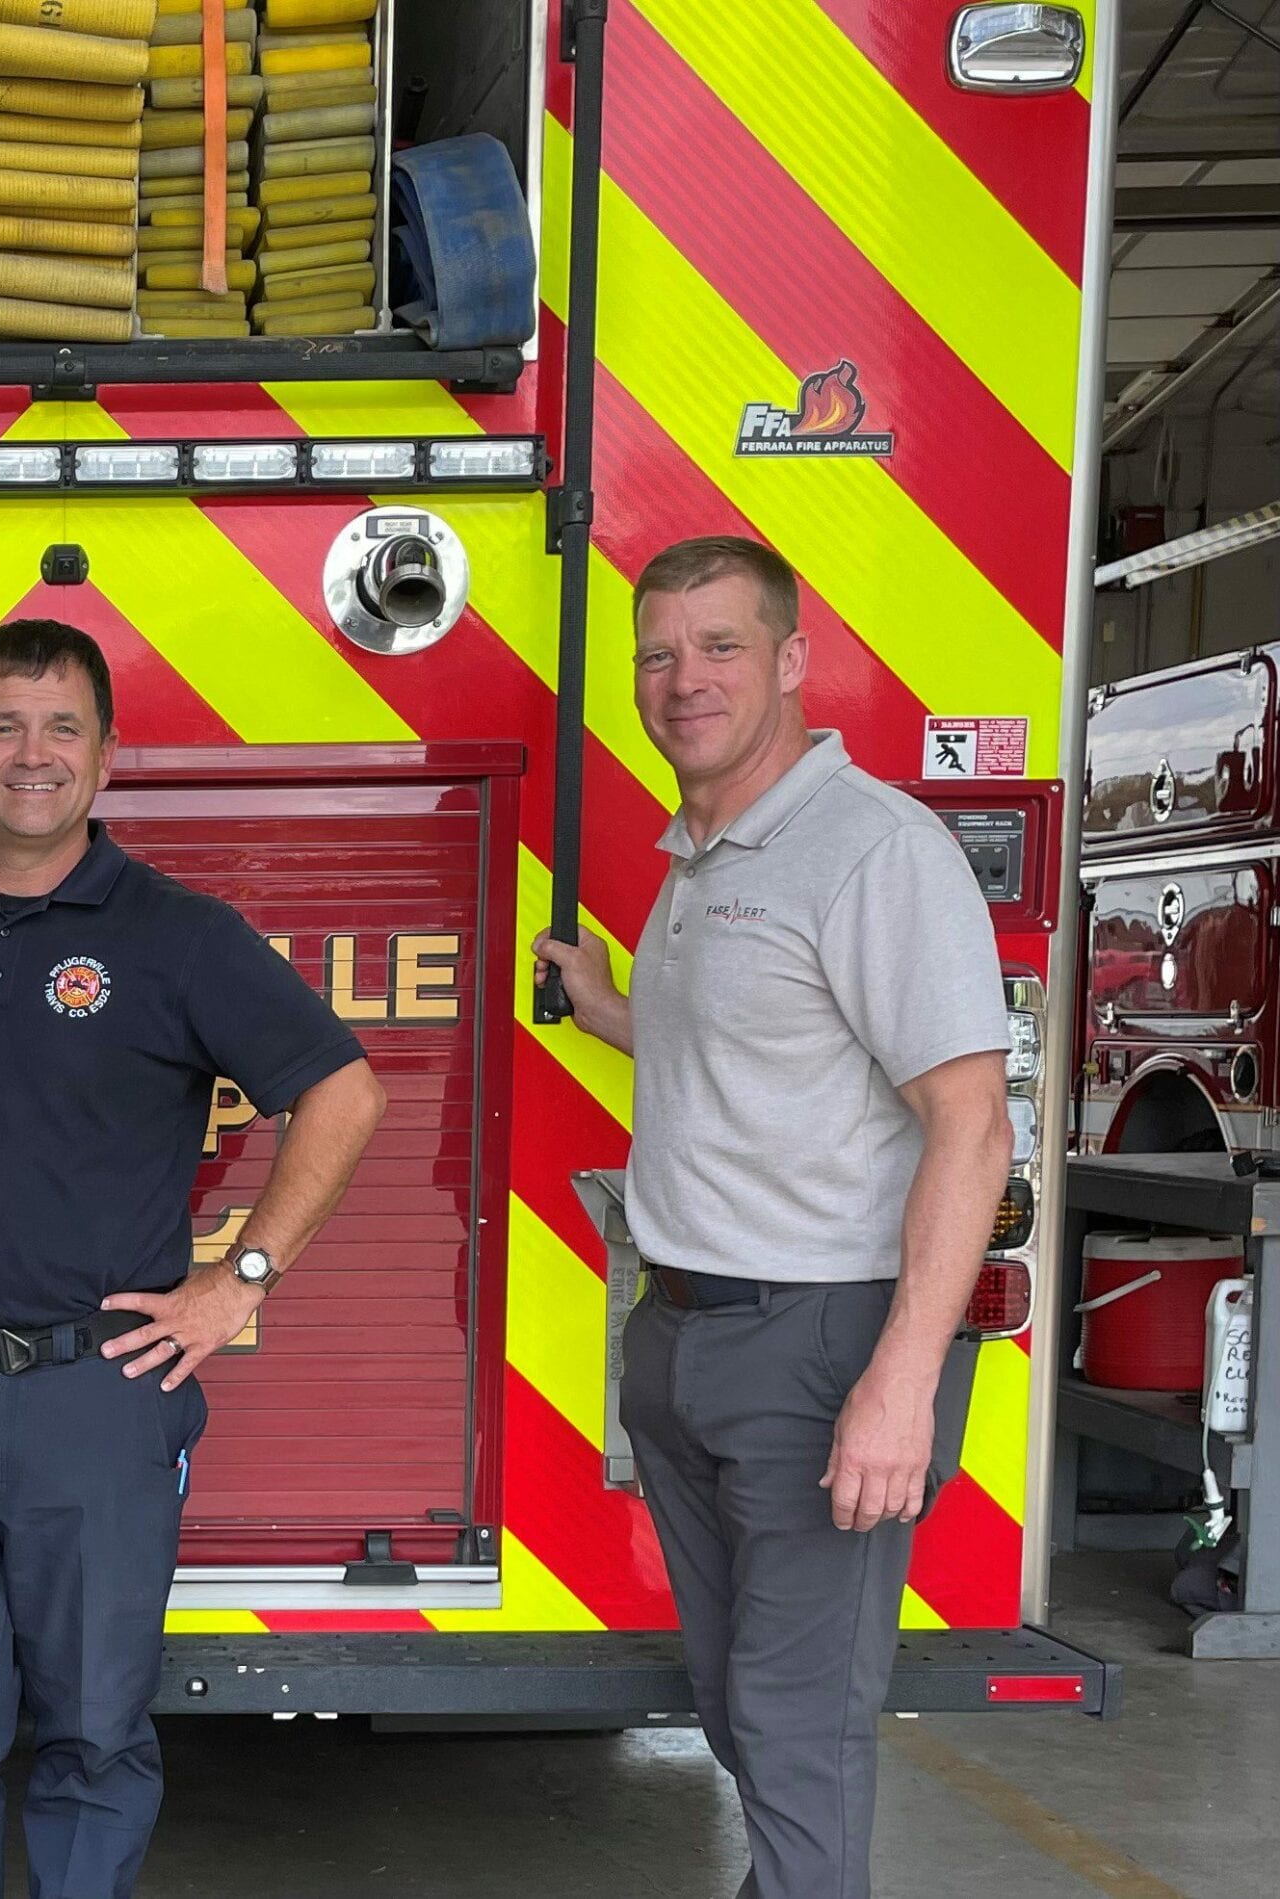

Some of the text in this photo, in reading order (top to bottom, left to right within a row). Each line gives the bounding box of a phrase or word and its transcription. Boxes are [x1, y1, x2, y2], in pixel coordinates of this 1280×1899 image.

[740, 405, 792, 438] FFA
[741, 440, 889, 452] FERRARA FIRE APPARATUS
[49, 956, 111, 985] PFLUGERVILLE
[45, 981, 65, 1013] TRAVIS
